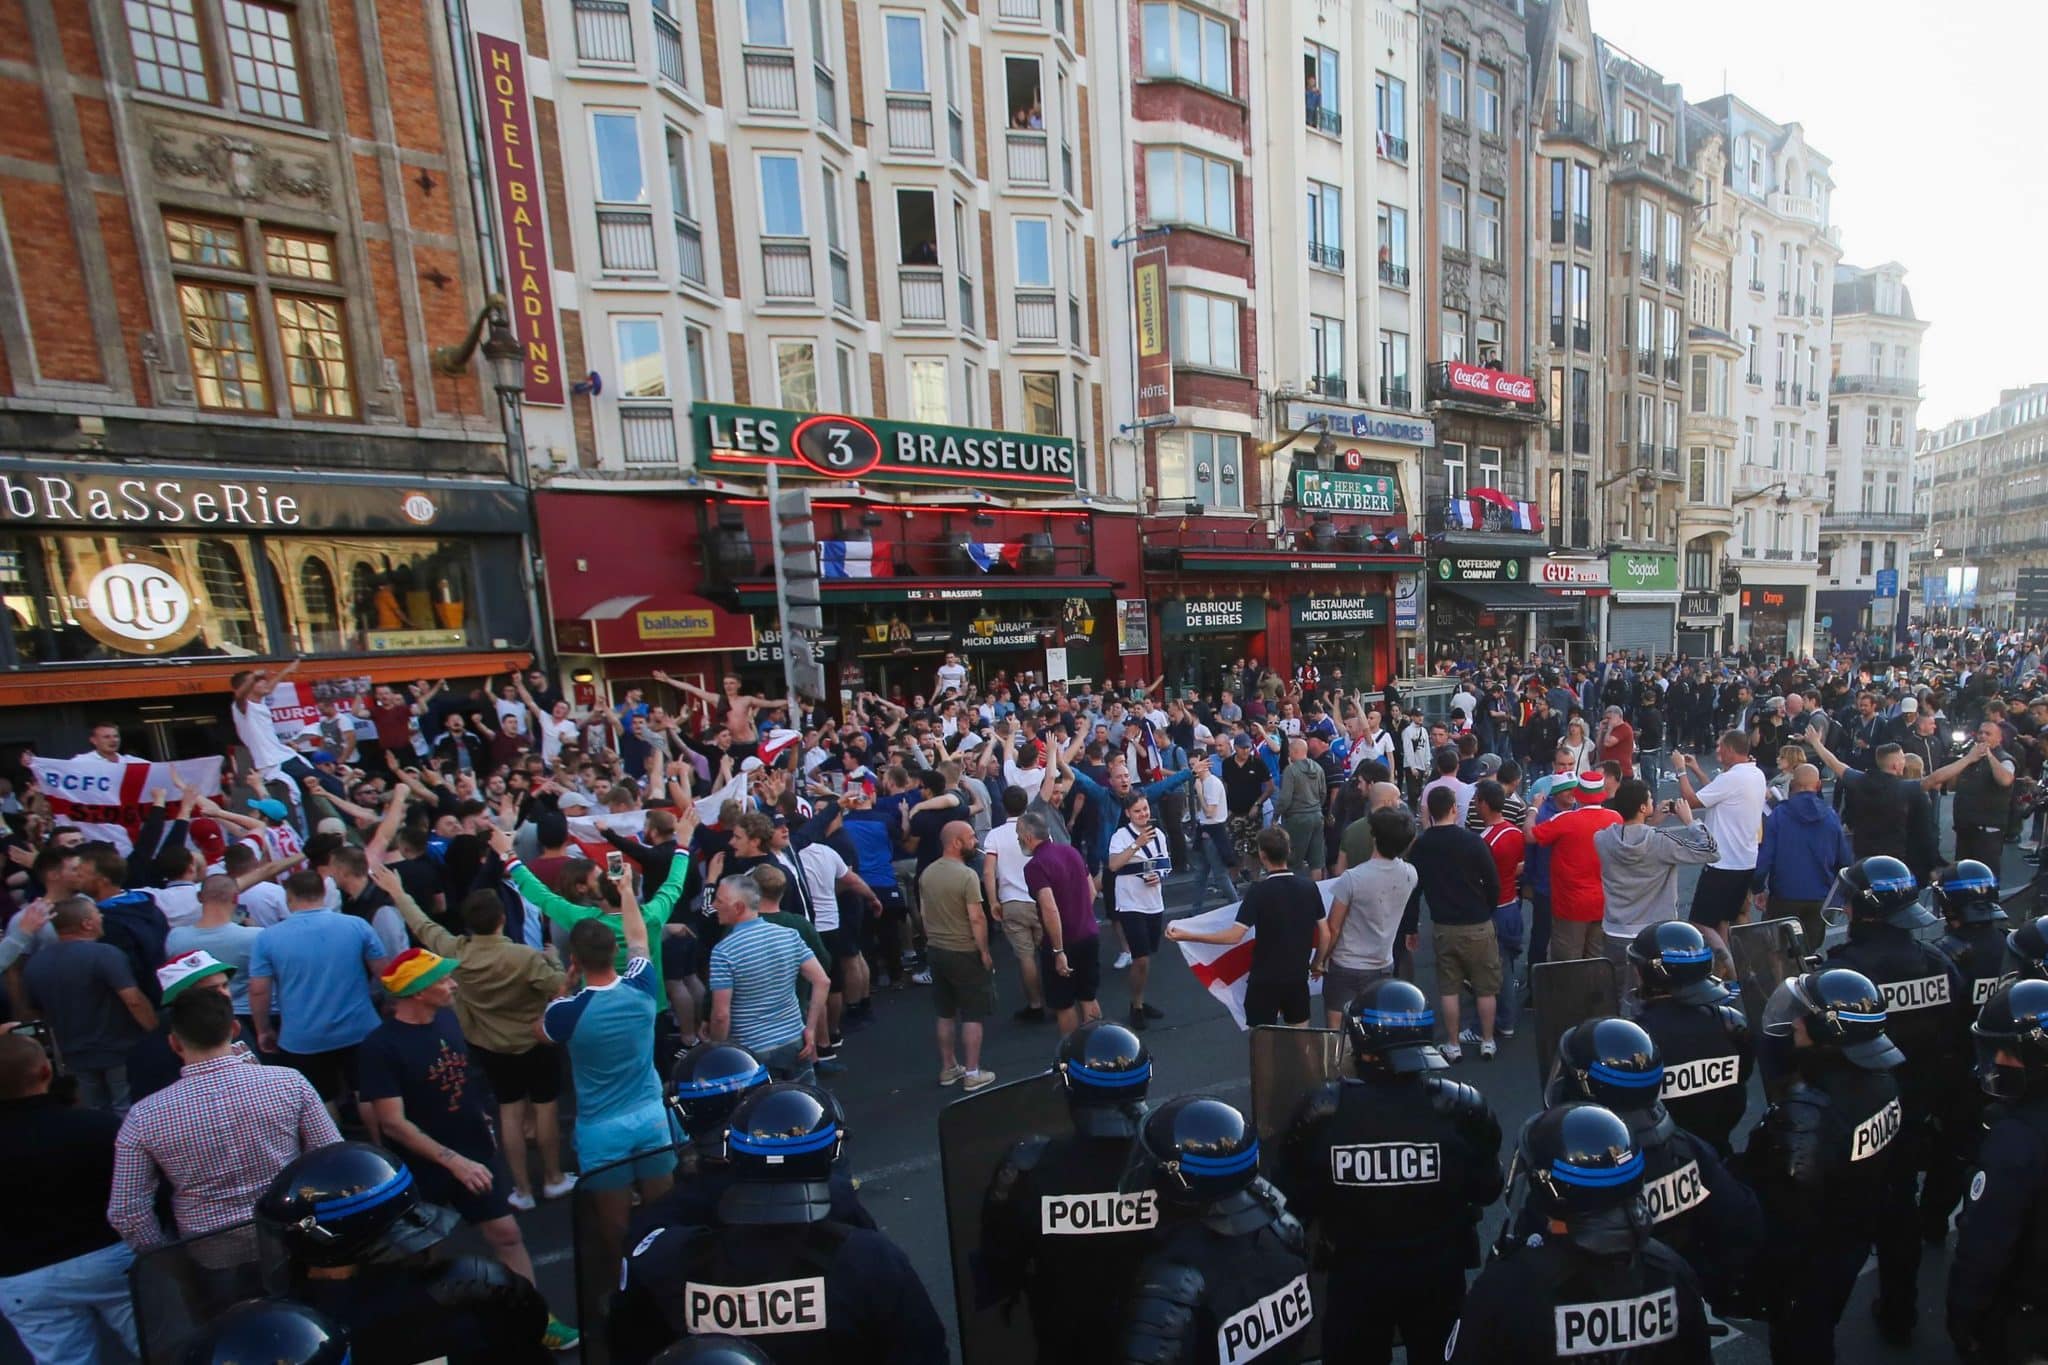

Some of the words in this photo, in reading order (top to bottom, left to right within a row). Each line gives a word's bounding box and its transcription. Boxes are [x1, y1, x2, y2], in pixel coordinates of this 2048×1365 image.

[491, 48, 524, 170] HOTEL
[509, 181, 550, 385] BALLADINS
[1144, 272, 1154, 349] balladins
[1369, 418, 1424, 441] LONDRES
[708, 415, 780, 452] LES
[827, 428, 853, 466] 3
[896, 432, 1073, 474] BRASSEURS
[1347, 453, 1359, 466] ICI
[1334, 481, 1361, 493] HERE
[409, 496, 431, 519] QG
[1303, 491, 1351, 508] CRAFT
[1353, 494, 1389, 511] BEER
[1457, 559, 1502, 569] COFFEESHOP
[1627, 557, 1660, 585] Sogood
[1462, 570, 1497, 580] COMPANY
[104, 575, 178, 632] QG
[907, 590, 921, 599] LES
[941, 589, 983, 598] BRASSEURS
[1310, 598, 1365, 610] RESTAURANT
[1185, 601, 1242, 614] FABRIQUE
[1301, 610, 1330, 622] MICRO
[1331, 608, 1375, 621] BRASSERIE
[1688, 598, 1712, 614] PAUL
[643, 616, 709, 632] balladins
[1186, 614, 1202, 627] DE
[1204, 613, 1243, 626] BIERES
[962, 637, 992, 647] MICRO
[993, 634, 1038, 645] BRASSERIE
[746, 647, 769, 662] DE
[45, 772, 111, 792] BCFC
[1883, 977, 1947, 1008] POLICE
[1661, 1059, 1735, 1095] POLICE
[1335, 1147, 1436, 1181] POLICE
[1049, 1196, 1152, 1229] POLICE
[691, 1285, 816, 1329] POLICE
[1223, 1282, 1310, 1363] POLICE
[1565, 1296, 1673, 1350] POLICE
